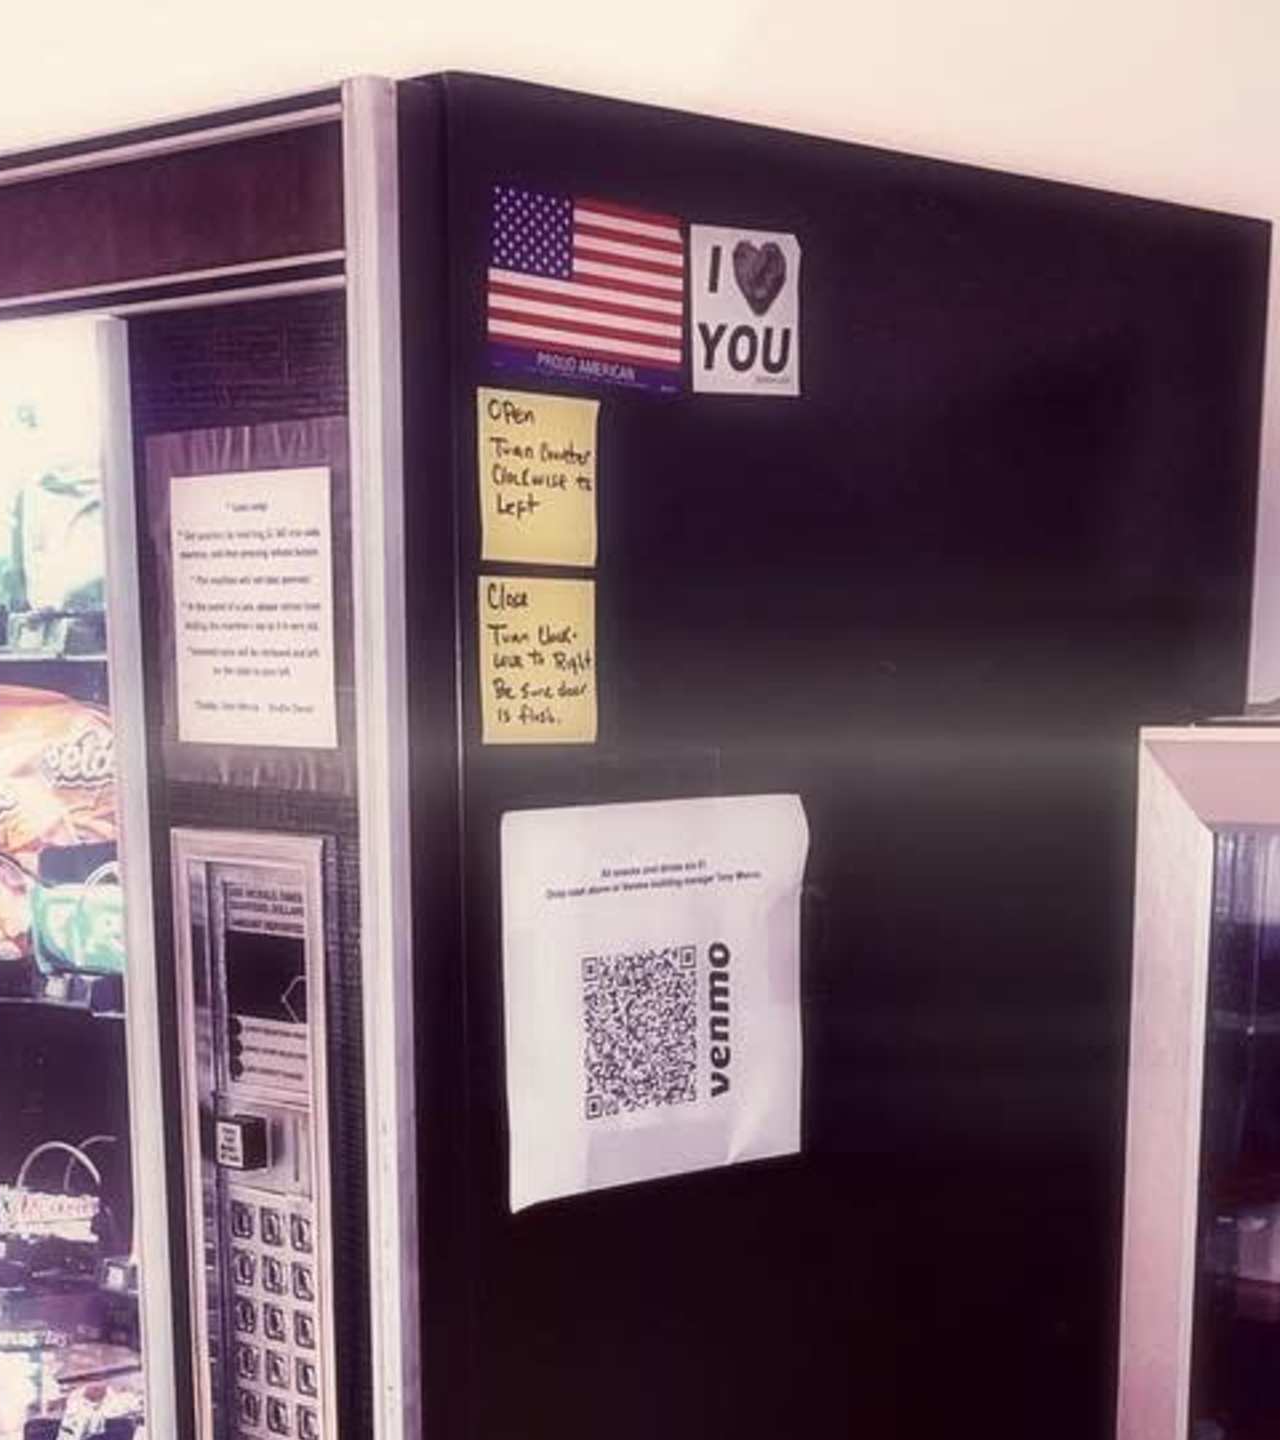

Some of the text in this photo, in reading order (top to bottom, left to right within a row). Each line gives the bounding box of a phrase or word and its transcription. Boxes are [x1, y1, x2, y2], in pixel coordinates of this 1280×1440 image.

[709, 245, 721, 293] I
[698, 324, 791, 374] YOU
[709, 942, 731, 1098] venmo
